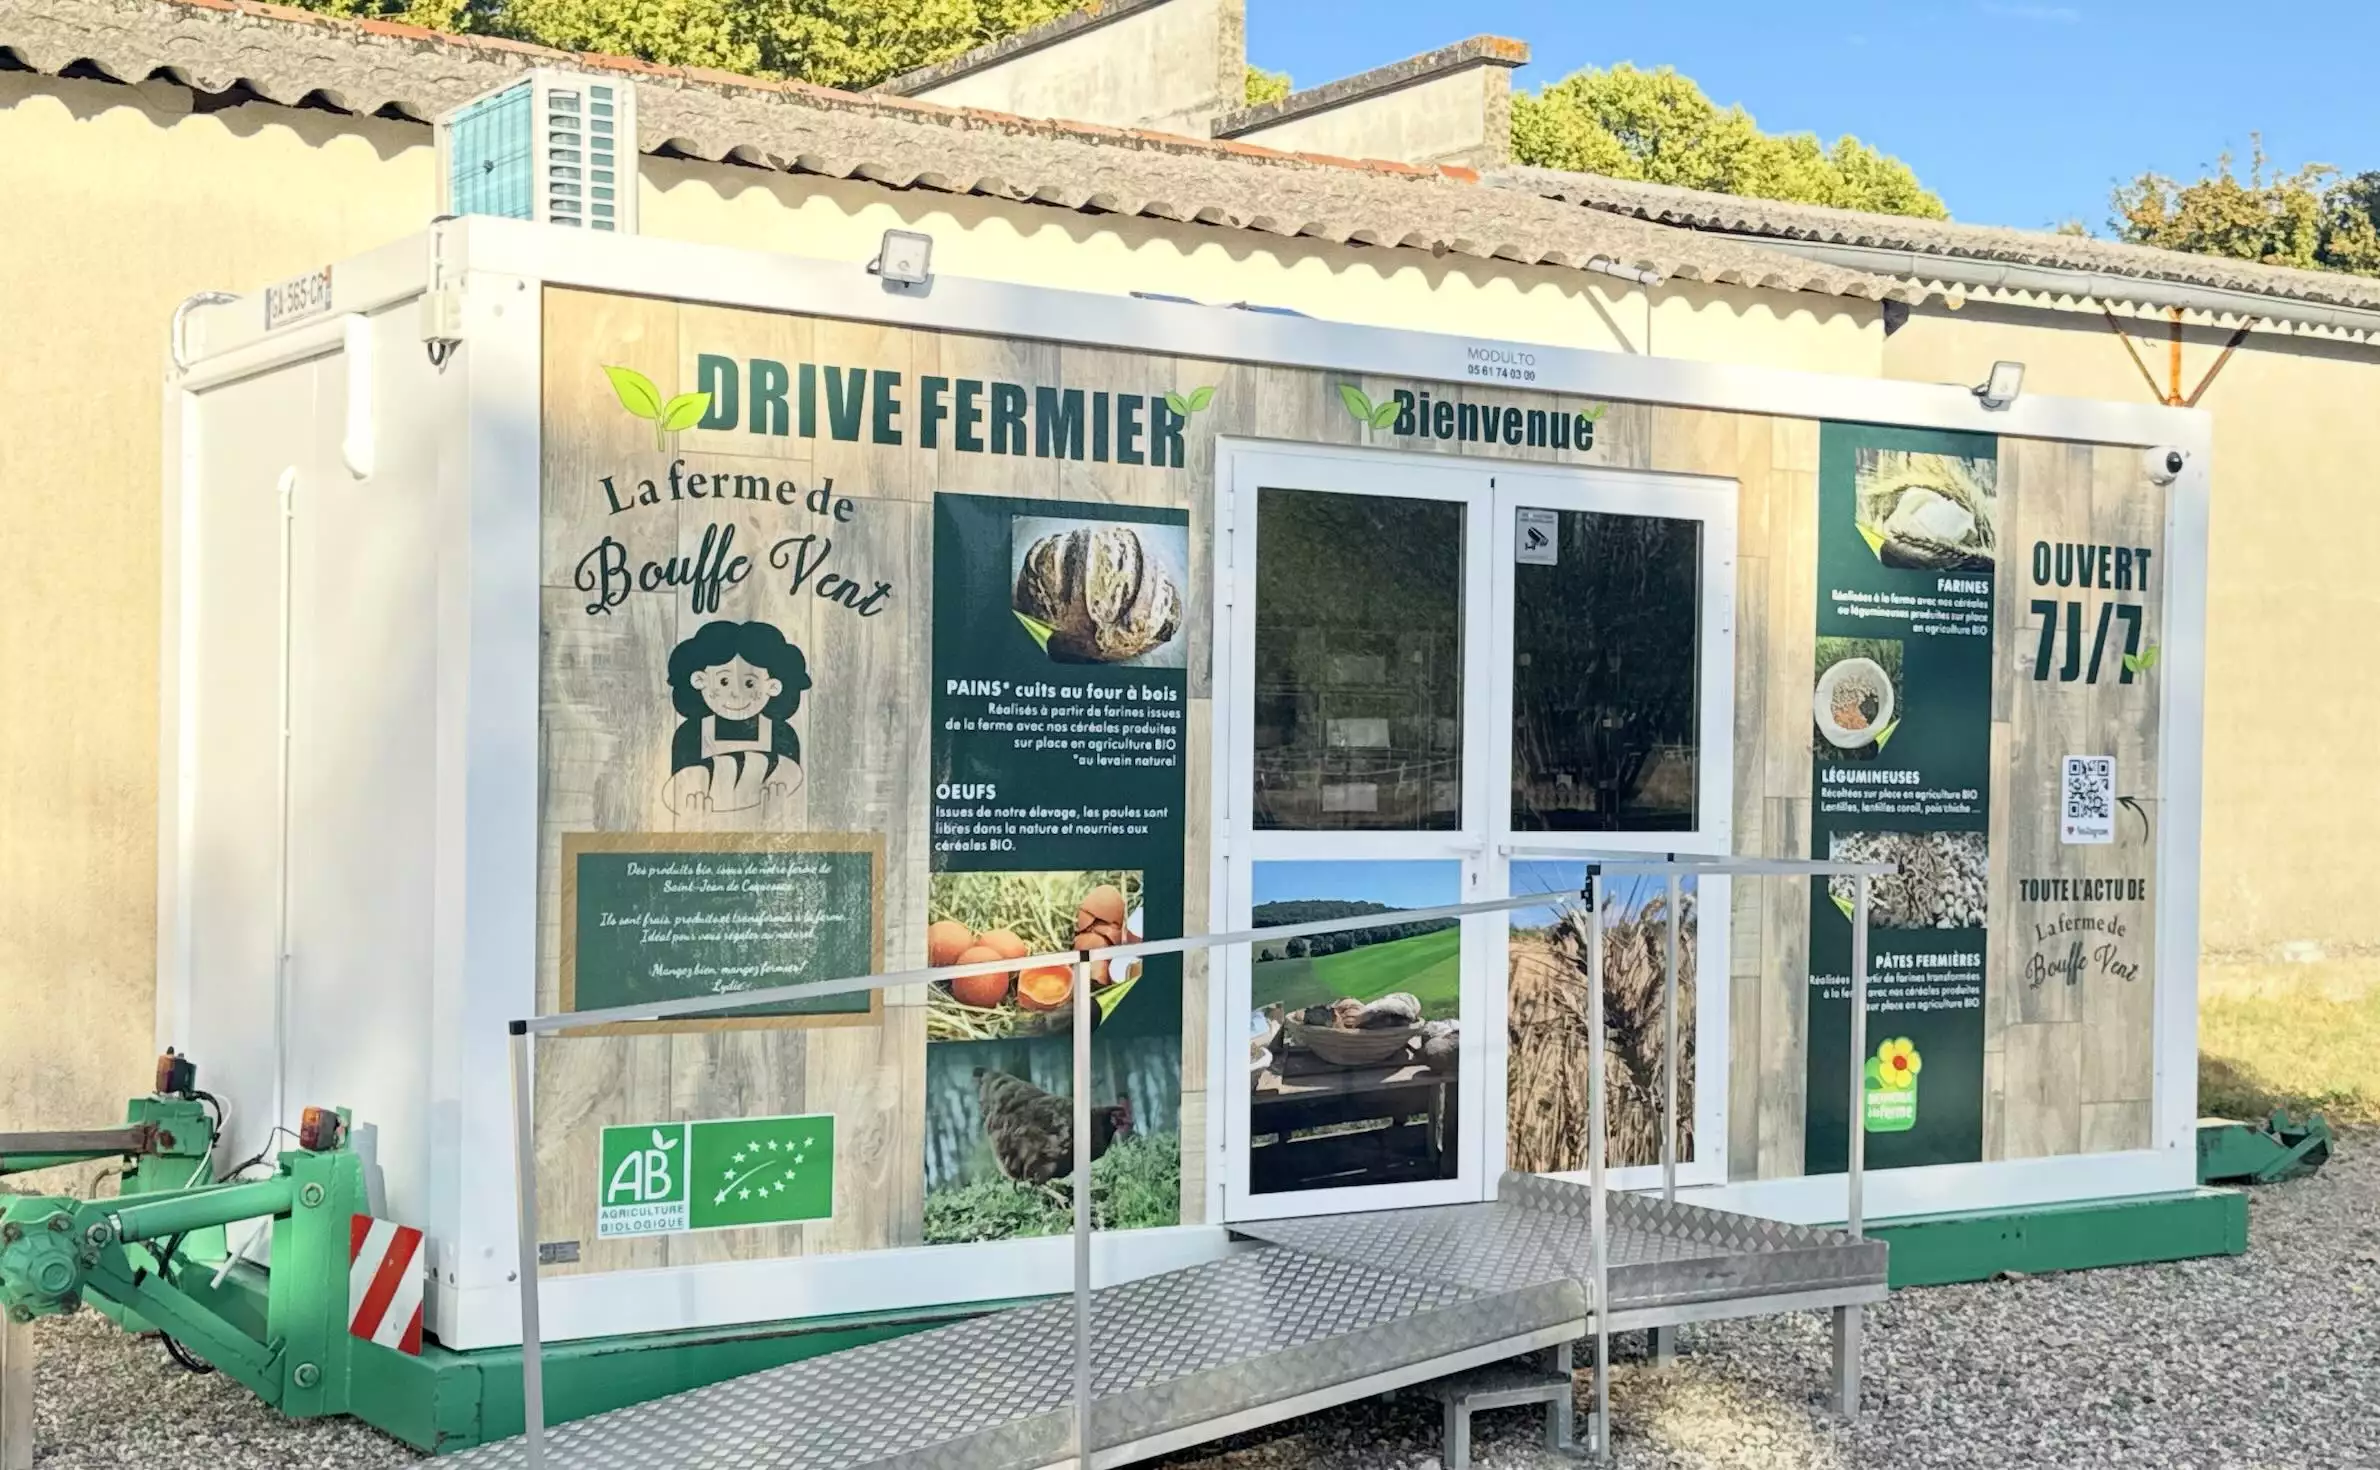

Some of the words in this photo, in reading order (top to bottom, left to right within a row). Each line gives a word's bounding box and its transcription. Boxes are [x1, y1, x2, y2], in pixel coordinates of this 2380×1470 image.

[1467, 347, 1535, 366] MODULTO
[1468, 364, 1480, 375] 05
[1482, 365, 1493, 376] 61
[1496, 367, 1507, 378] 74
[1510, 368, 1521, 379] 03
[1524, 370, 1535, 381] 00
[697, 354, 902, 445] DRIVE
[919, 375, 1185, 468] FERMIER
[1393, 389, 1594, 451] Bienvenue
[599, 472, 661, 516] La
[668, 459, 796, 507] ferme
[806, 477, 855, 523] de
[574, 522, 753, 616] Bouffe
[769, 533, 899, 618] Vent
[2033, 541, 2152, 591] OUVERT
[1937, 578, 1989, 594] FARINES
[1874, 592, 1880, 603] à
[1881, 592, 1889, 603] la
[1891, 592, 1916, 605] ferme
[1917, 596, 1936, 607] avec
[1937, 598, 1952, 608] nos
[1954, 597, 1988, 609] céréales
[1850, 604, 1909, 619] légumineuses
[1910, 609, 1950, 621] produites
[1951, 612, 1964, 621] sur
[1965, 611, 1988, 624] place
[1913, 624, 1924, 633] en
[1925, 623, 1970, 636] agriculture
[1972, 625, 1988, 636] BIO
[2031, 599, 2142, 684] 7J/7
[1015, 681, 1056, 698] cuits
[1060, 685, 1083, 699] au
[1086, 683, 1123, 700] four
[1127, 685, 1138, 700] à
[1142, 685, 1177, 701] bois
[988, 702, 1038, 716] Réalisés
[1040, 704, 1048, 716] à
[1051, 704, 1084, 720] partir
[1087, 705, 1101, 717] de
[1103, 705, 1144, 718] farines
[1147, 707, 1181, 719] issues
[945, 719, 961, 731] de
[964, 719, 975, 731] la
[977, 719, 1013, 732] ferme
[1016, 722, 1044, 732] avec
[1047, 723, 1068, 733] nos
[1070, 722, 1119, 734] céréales
[1122, 723, 1176, 738] produites
[1014, 739, 1033, 749] sur
[1035, 737, 1068, 751] place
[1071, 740, 1085, 749] en
[1088, 738, 1151, 753] agriculture
[1155, 739, 1176, 750] BIO
[1097, 754, 1132, 766] levain
[1135, 754, 1176, 767] naturel
[1821, 766, 1920, 785] LÉGUMINEUSES
[935, 784, 996, 800] OEUFS
[1821, 787, 1862, 799] Récoltées
[1863, 789, 1877, 799] sur
[1878, 788, 1901, 800] place
[1903, 790, 1914, 800] en
[1915, 789, 1960, 801] agriculture
[1962, 789, 1978, 800] BIO
[935, 806, 974, 818] Issues
[976, 806, 992, 818] de
[994, 806, 1026, 818] notre
[1029, 805, 1080, 820] élevage,
[1083, 806, 1100, 818] les
[1102, 806, 1141, 820] poules
[1143, 807, 1168, 819] sont
[1821, 802, 1860, 813] Lentilles,
[1862, 802, 1895, 813] lentilles
[1925, 803, 1942, 815] pois
[1944, 803, 1970, 813] chiche
[935, 822, 971, 834] libres
[973, 822, 1002, 835] dans
[1005, 822, 1016, 835] la
[1019, 823, 1058, 835] nature
[1061, 823, 1073, 835] et
[1075, 823, 1125, 835] nourries
[1127, 826, 1148, 835] aux
[934, 838, 987, 851] céréales
[989, 839, 1016, 851] BIO.
[627, 862, 646, 877] Des
[648, 861, 693, 878] produits
[745, 863, 758, 874] de
[663, 879, 725, 893] Saint-Jean
[726, 880, 740, 892] de
[2019, 879, 2068, 902] TOUTE
[2073, 879, 2124, 901] L'ACTU
[2128, 879, 2145, 901] DE
[600, 912, 616, 927] Ils
[618, 914, 642, 926] sont
[2036, 922, 2056, 942] La
[2058, 912, 2104, 933] ferme
[2107, 916, 2127, 938] de
[640, 929, 672, 944] Idéal
[1875, 952, 1913, 969] PÂTES
[1916, 951, 1981, 967] FERMIÈRES
[2025, 941, 2088, 990] Bouffe
[2094, 943, 2139, 982] Vent
[651, 963, 692, 978] Mangez
[720, 965, 759, 977] mangez
[1810, 974, 1850, 985] Réalisées
[1884, 972, 1895, 983] de
[1896, 972, 1925, 982] farines
[1926, 970, 1980, 982] transformées
[1823, 988, 1829, 999] à
[1831, 987, 1840, 998] la
[1868, 989, 1887, 997] avec
[1888, 988, 1903, 997] nos
[1905, 984, 1940, 996] céréales
[1941, 984, 1980, 997] produites
[1881, 1000, 1903, 1013] place
[1905, 1001, 1916, 1010] en
[1917, 998, 1962, 1011] agriculture
[1964, 997, 1980, 1008] BIO
[607, 1150, 672, 1203] AB
[600, 1204, 684, 1219] AGRICULTURE
[600, 1217, 683, 1233] BIOLOGIQUE
